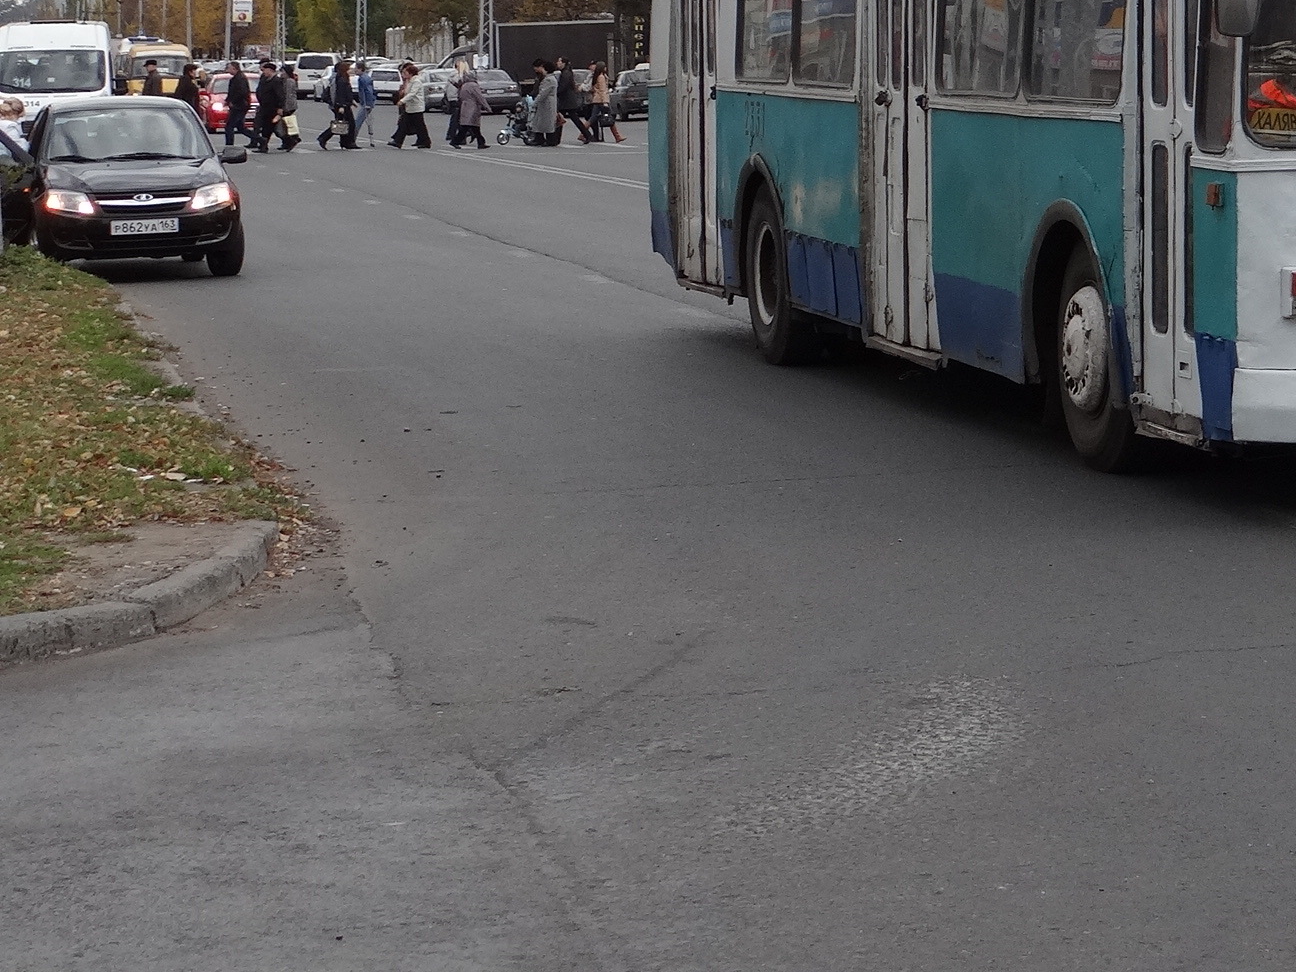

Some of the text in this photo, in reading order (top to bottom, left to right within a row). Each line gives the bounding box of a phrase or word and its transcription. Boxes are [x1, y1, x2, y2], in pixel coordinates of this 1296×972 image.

[13, 77, 31, 88] 314
[23, 100, 40, 108] 314
[114, 219, 176, 233] Р862УА 163
